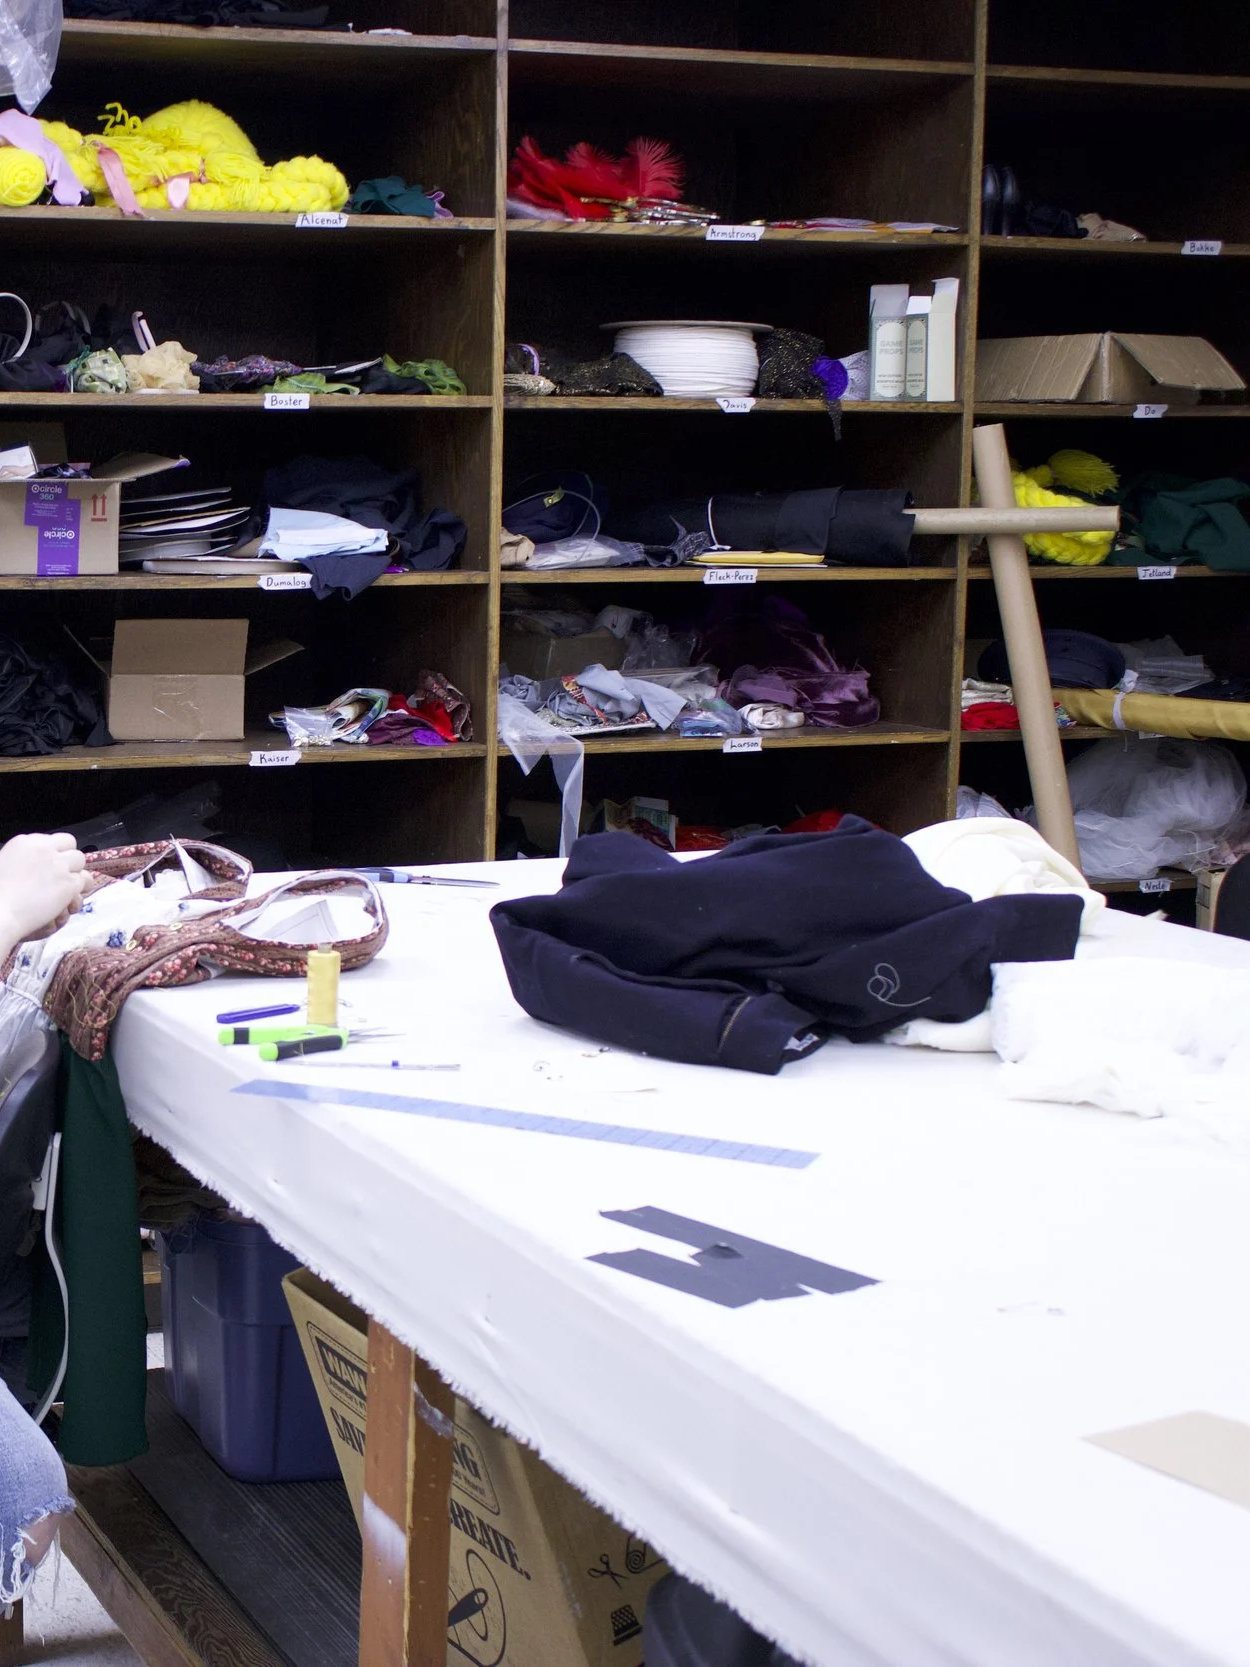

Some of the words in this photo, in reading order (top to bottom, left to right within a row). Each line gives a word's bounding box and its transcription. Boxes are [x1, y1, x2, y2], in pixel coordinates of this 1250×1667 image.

[301, 213, 343, 226] Alcenat
[711, 228, 757, 241] Armstrong
[40, 484, 62, 494] circle
[44, 530, 66, 540] circle
[709, 571, 754, 581] Fleck-Perez
[266, 577, 307, 588] Dumalog
[729, 739, 759, 749] Larson
[259, 753, 289, 764] Kaiser
